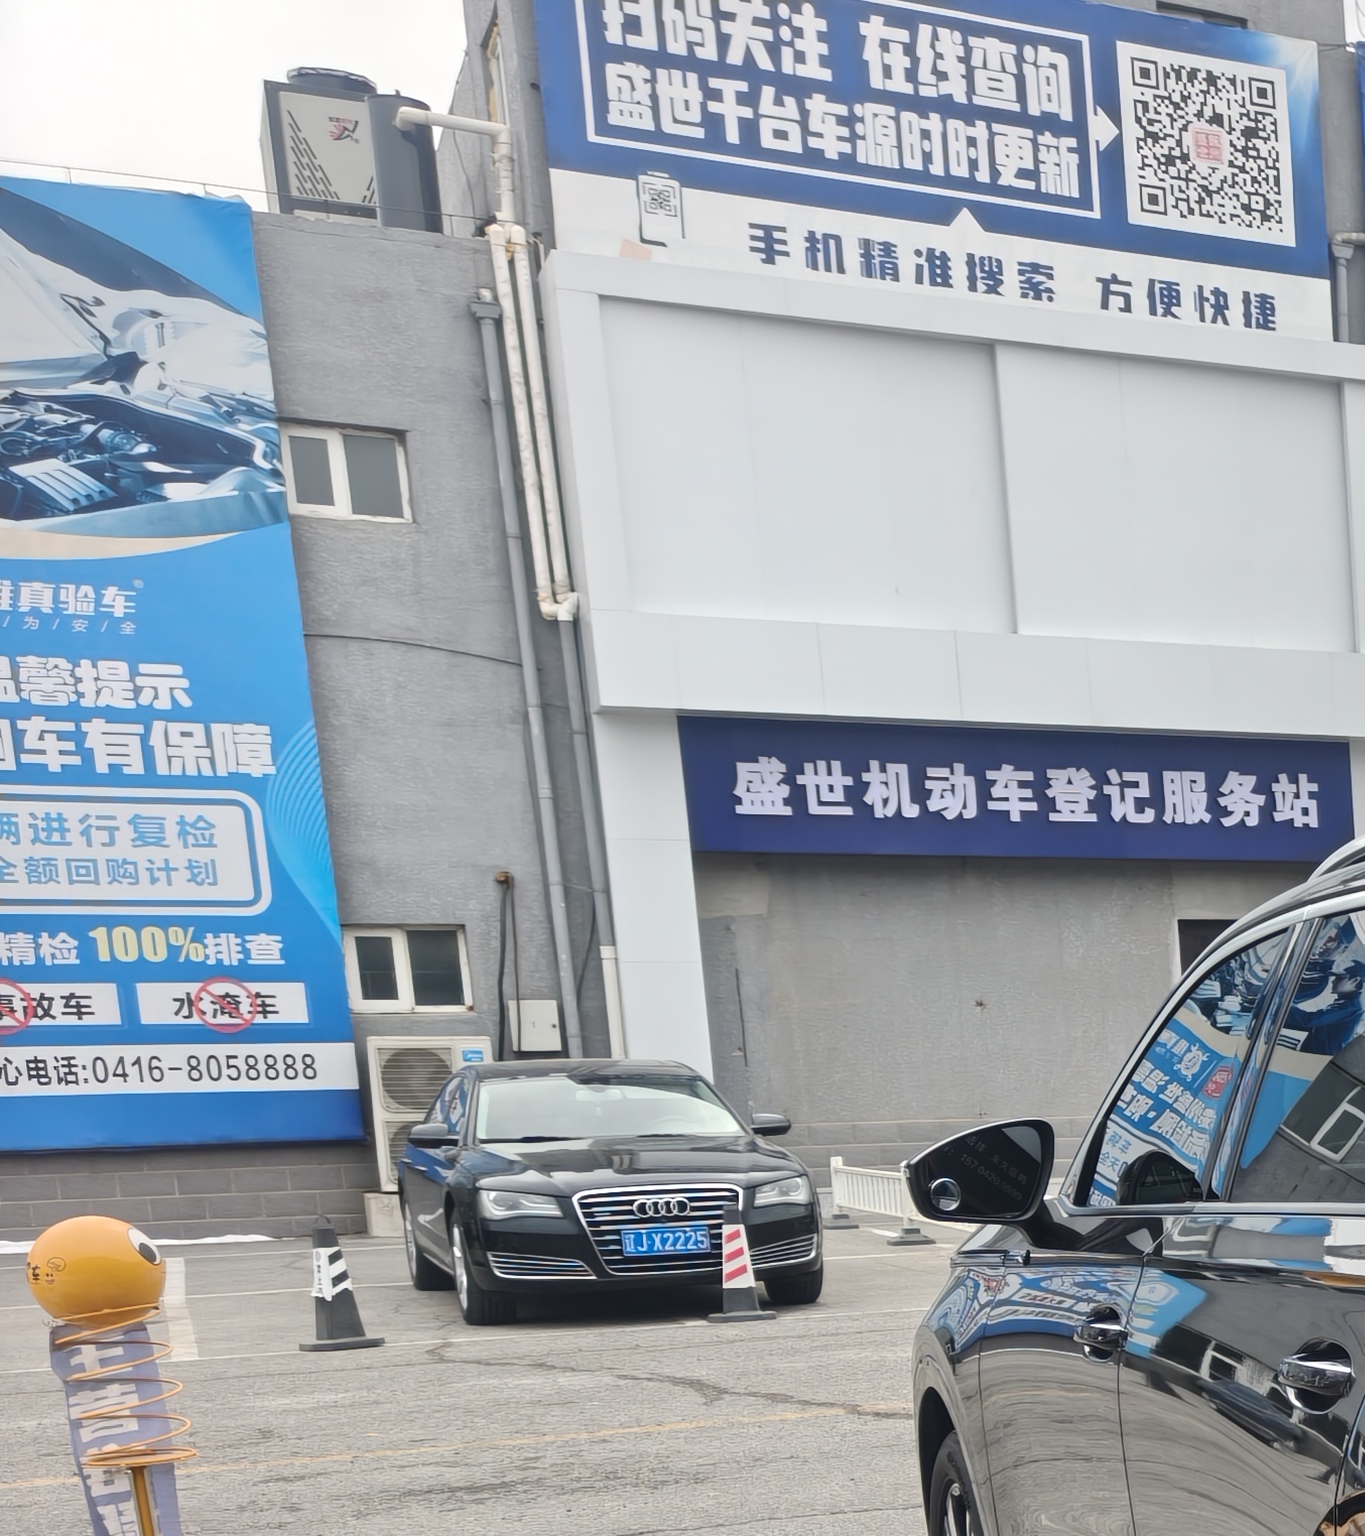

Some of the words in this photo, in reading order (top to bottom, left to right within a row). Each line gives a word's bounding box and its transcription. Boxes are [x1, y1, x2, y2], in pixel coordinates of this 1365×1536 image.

[601, 0, 832, 81] 扫码关注
[859, 15, 1072, 121] 在线查询
[603, 62, 1081, 199] 盛世千台车源时时更新
[749, 222, 1058, 304] 手机精准搜索
[1095, 273, 1279, 332] 方便快捷
[0, 716, 277, 778] 车有保障
[732, 755, 1320, 829] 盛世机动车登记服务站
[172, 990, 281, 1021] 水淹车
